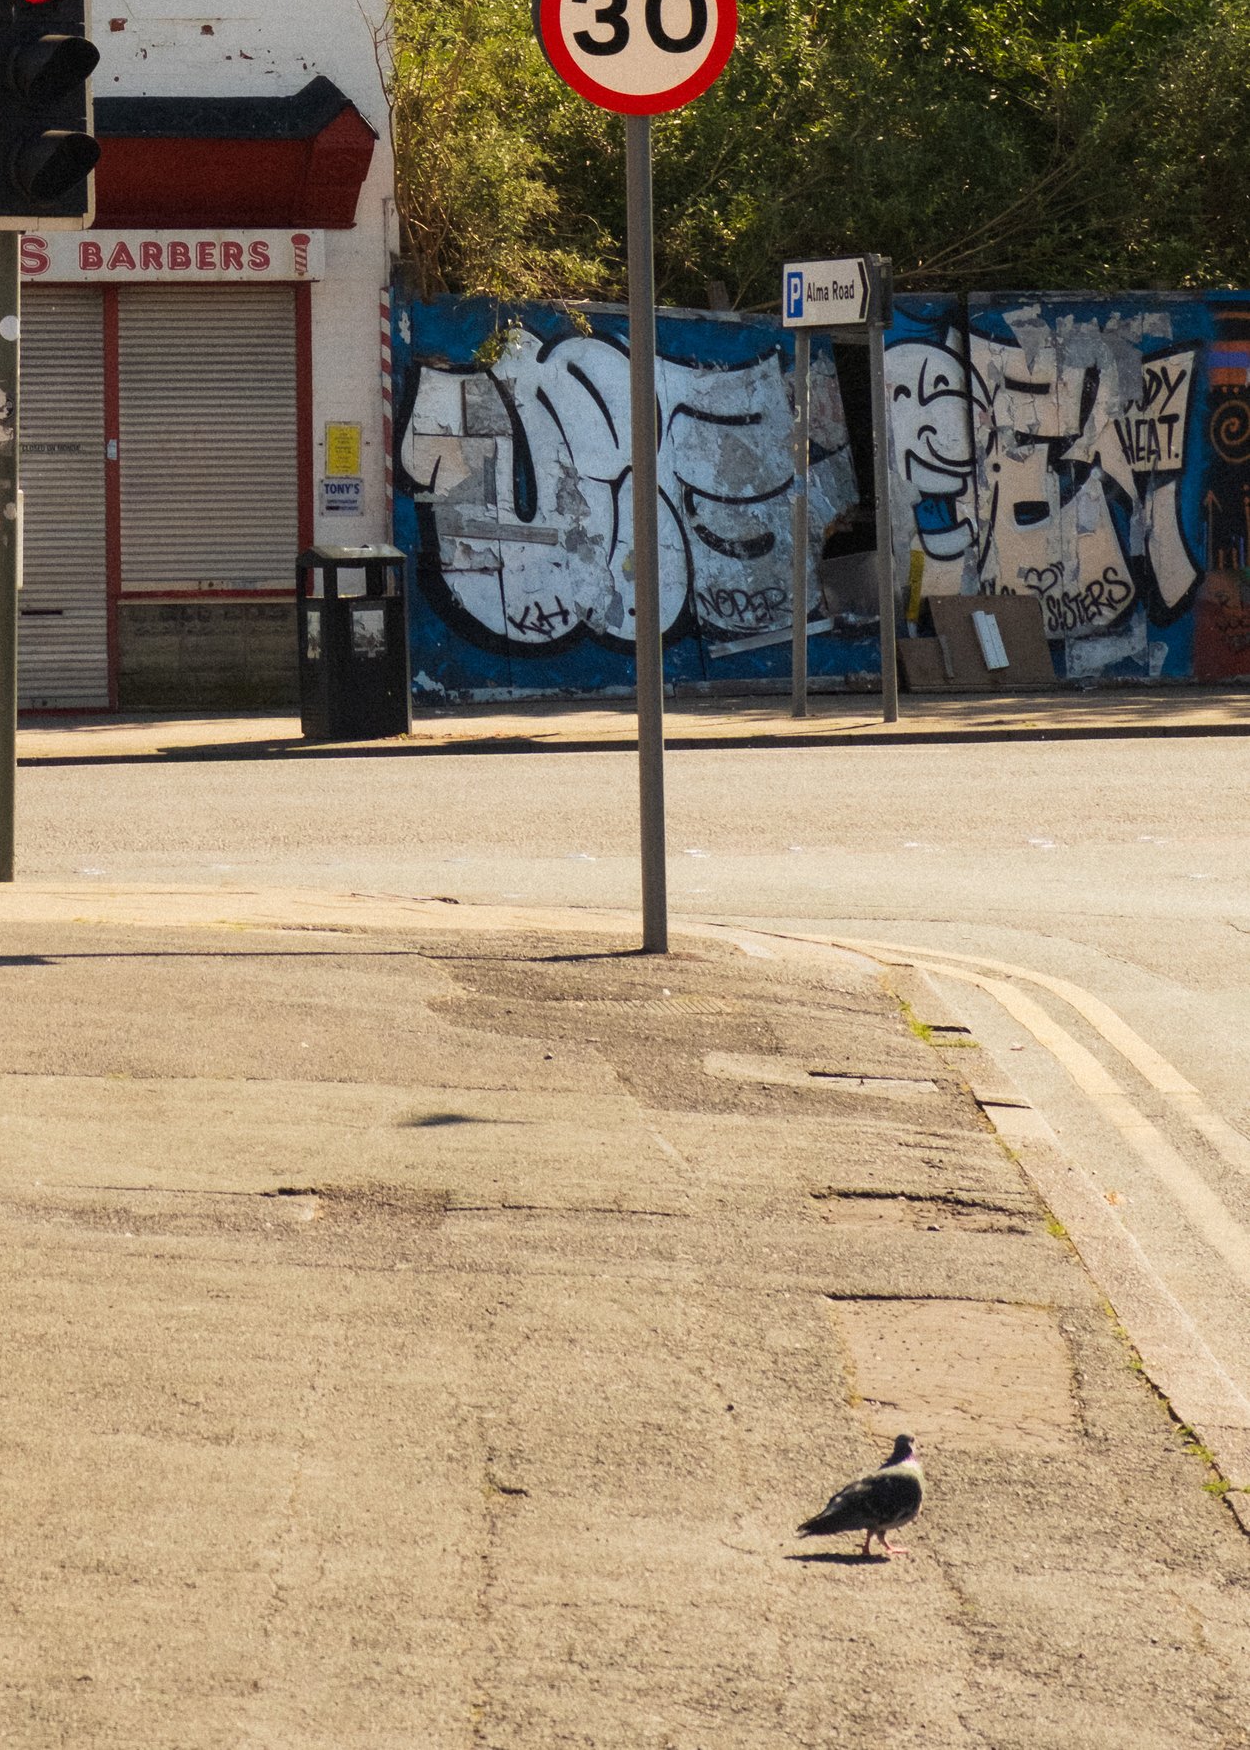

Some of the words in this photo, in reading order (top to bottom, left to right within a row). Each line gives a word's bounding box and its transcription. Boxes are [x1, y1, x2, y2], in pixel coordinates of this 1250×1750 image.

[78, 240, 271, 272] BARBERS
[806, 282, 829, 302] Alma
[832, 279, 855, 301] Road
[324, 483, 360, 494] TONY'S
